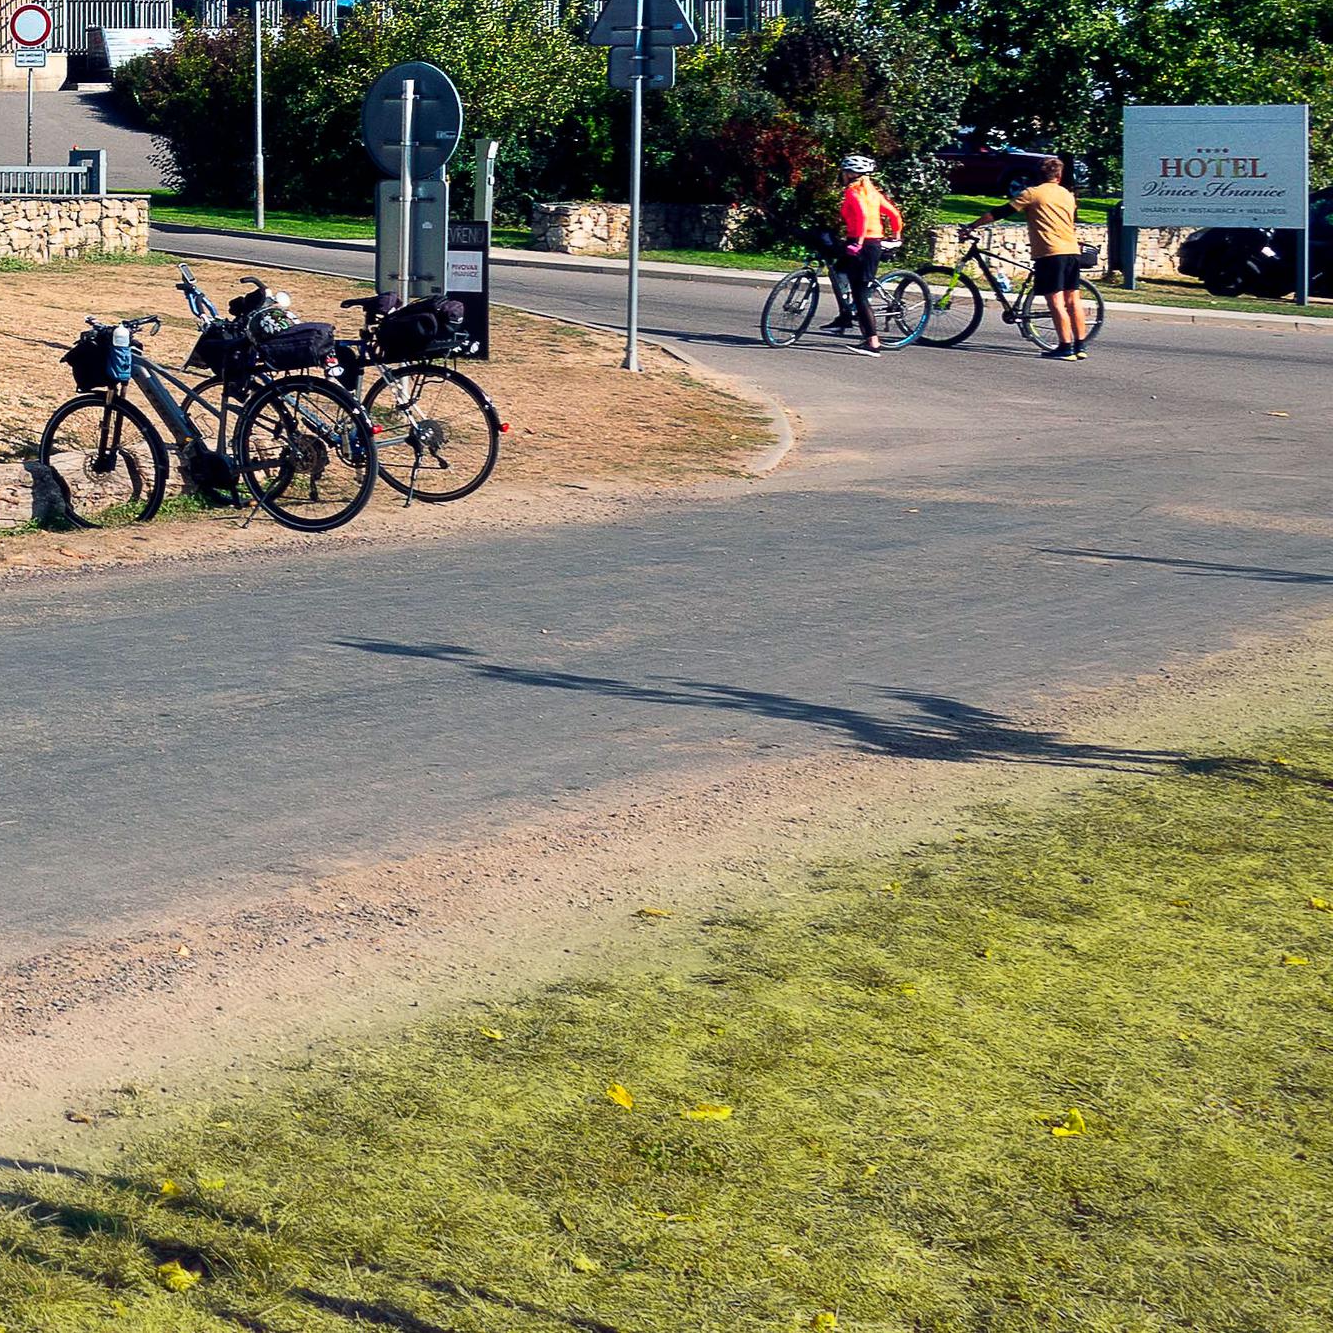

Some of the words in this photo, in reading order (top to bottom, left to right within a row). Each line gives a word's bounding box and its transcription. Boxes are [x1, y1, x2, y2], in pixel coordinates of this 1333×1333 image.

[1159, 157, 1268, 178] HOTEL
[1140, 180, 1199, 198] Vinice
[1202, 180, 1287, 198] Hnanice
